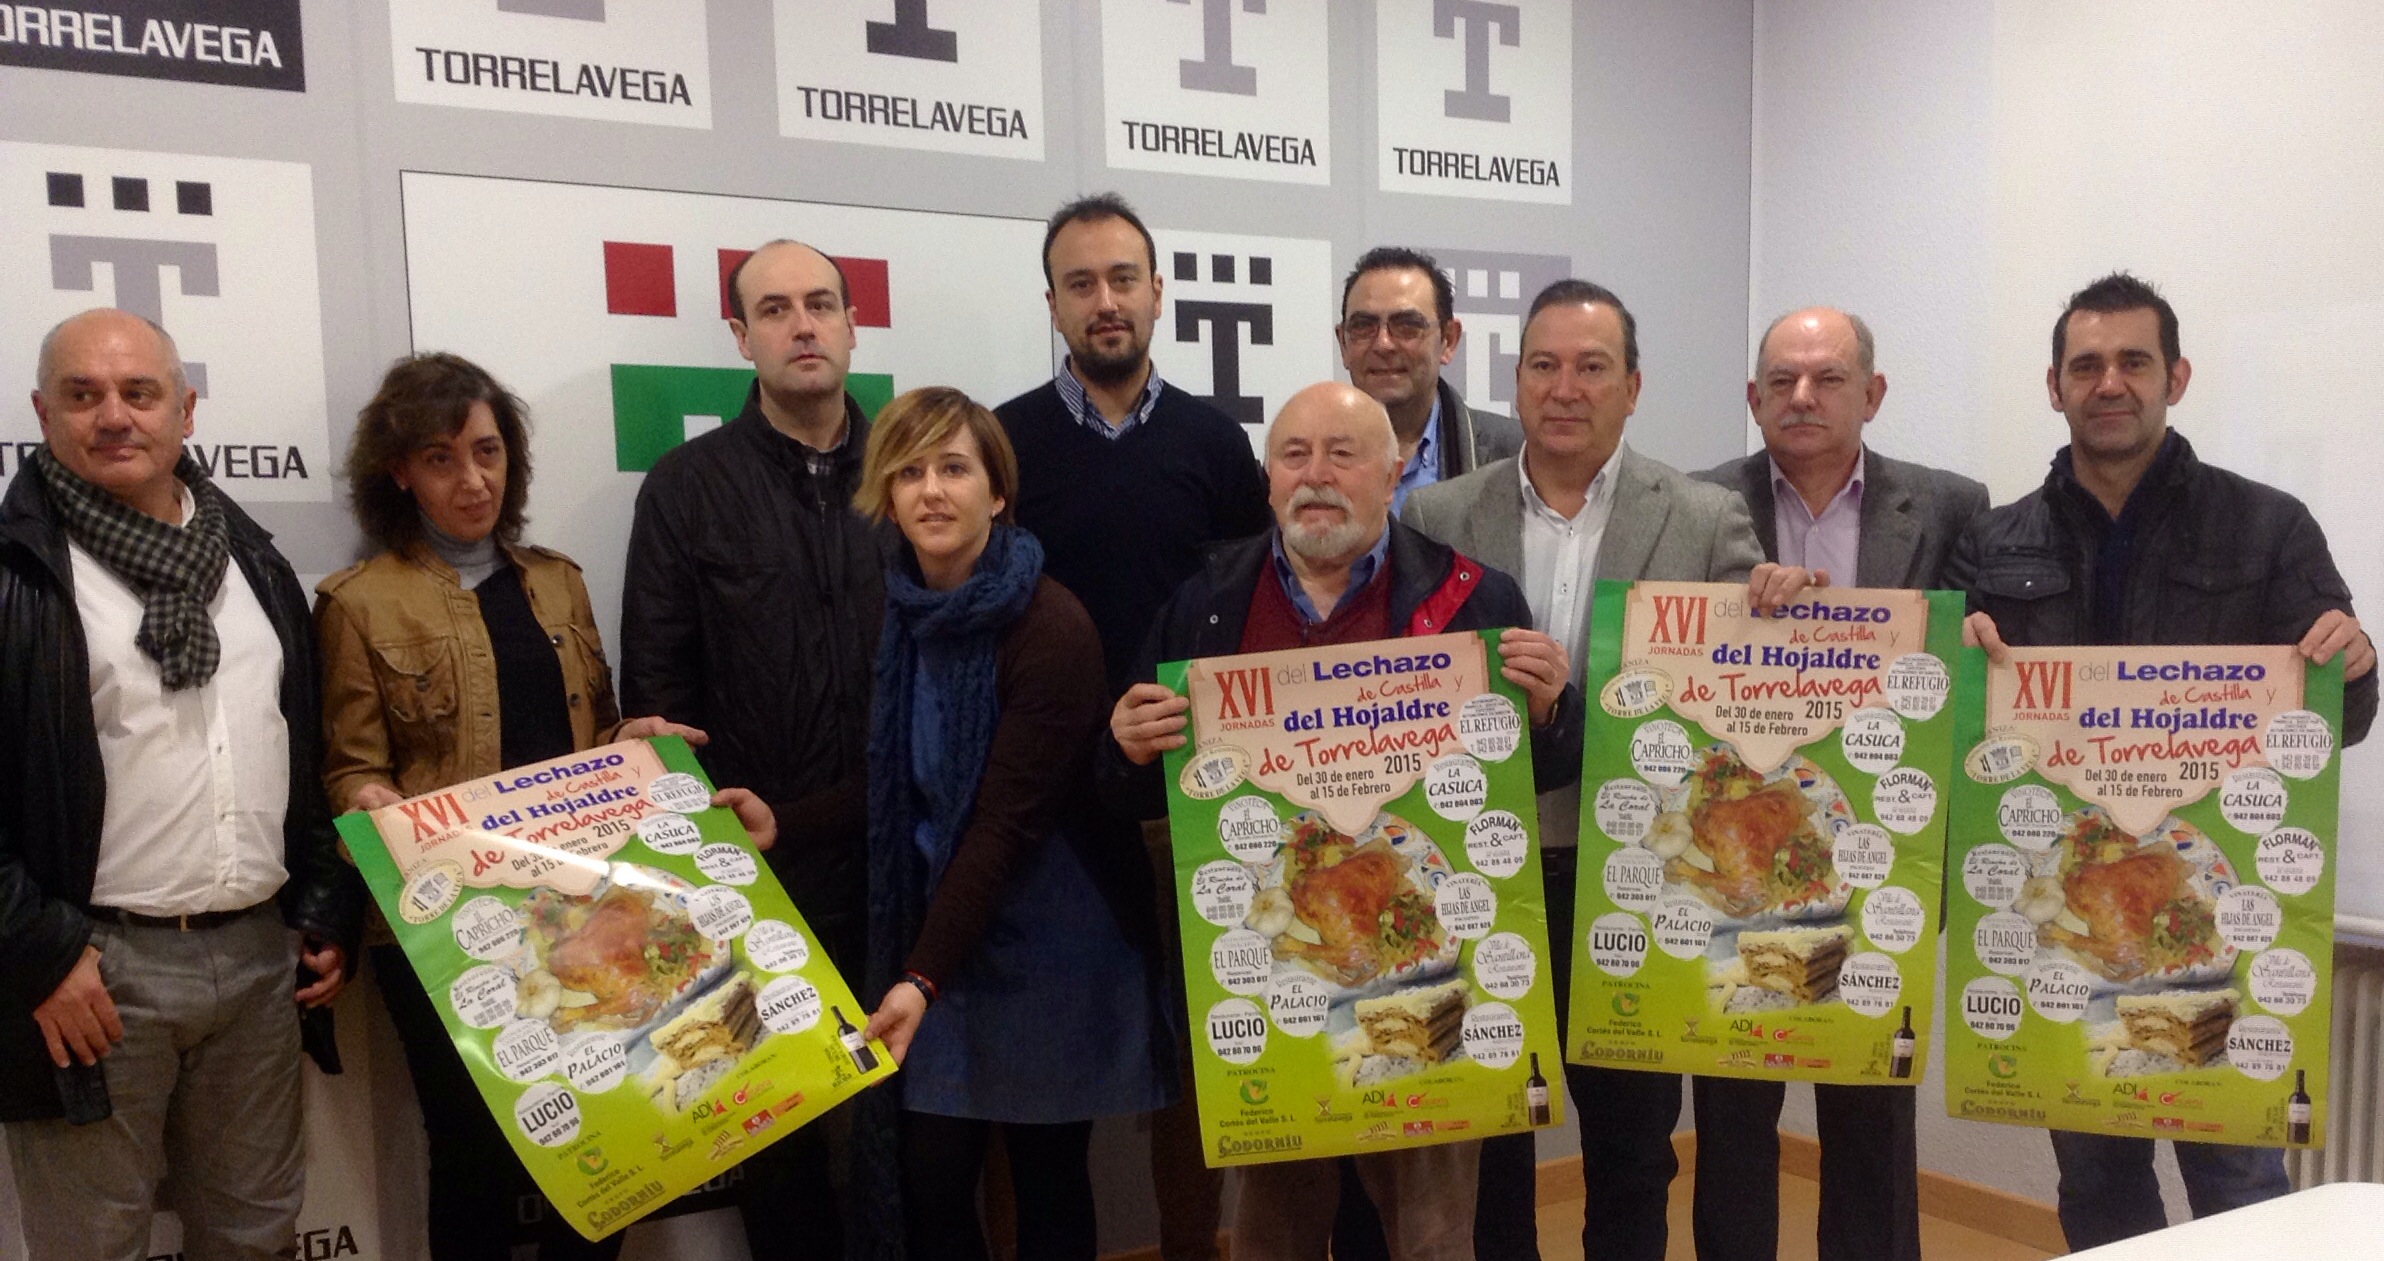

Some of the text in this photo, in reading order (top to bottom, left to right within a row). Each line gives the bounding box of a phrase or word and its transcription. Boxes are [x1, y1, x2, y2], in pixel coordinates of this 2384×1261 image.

[0, 4, 282, 67] ORRELAVEGA
[416, 47, 692, 106] TORRELAVEGA
[797, 86, 1028, 140] TORRELAVEGA
[1122, 120, 1316, 166] TORRELAVEGA
[1393, 147, 1560, 187] TORRELAVEGA
[1712, 597, 1743, 618] del
[1647, 594, 1708, 644] XVI
[1789, 624, 1898, 647] de Castilla y
[1648, 646, 1703, 656] JORNADAS
[1711, 642, 1752, 665] del
[1760, 645, 1880, 672] Hojaldre
[1277, 649, 1451, 685] del Lechazo
[2078, 660, 2266, 681] del Lechazo
[1215, 666, 1274, 719] XVI
[1357, 673, 1463, 702] de Castilla y
[1679, 675, 1716, 702] de
[1718, 668, 1881, 707] Torrelavega
[1887, 675, 1949, 691] EL REFUGIO
[2011, 660, 2072, 709] XVI
[2159, 683, 2276, 705] de Castilla y
[1283, 707, 1324, 732] del
[1331, 698, 1449, 729] Hojaldre
[1715, 700, 1843, 720] Del 30 de enero 2015
[2012, 712, 2069, 720] JORNADAS
[2078, 706, 2121, 728] del
[2130, 706, 2258, 734] Hojaldre
[1220, 718, 1275, 731] JORNADAS
[1460, 715, 1520, 733] EL REFUGIO
[1726, 720, 1808, 736] al 15 de Febrero
[1259, 747, 1294, 776] de
[1294, 723, 1456, 768] Torrelavega
[1631, 739, 1690, 761] CAPRICHO
[1845, 733, 1900, 747] CASUCA
[2046, 740, 2084, 766] de
[2086, 730, 2260, 767] Torrelavega
[2266, 734, 2332, 748] EL REFUGIO
[461, 783, 492, 803] del
[494, 751, 625, 794] Lechazo
[1297, 753, 1421, 786] Del 30 de enero 2015
[2085, 761, 2219, 782] Del 30 de enero 2015
[547, 766, 641, 801] de Castilla y
[1310, 780, 1390, 800] al 15 de Febrero
[1428, 779, 1482, 796] CASUCA
[1880, 773, 1931, 790] FLORMAN
[2097, 784, 2183, 798] al 15 de Febrero
[481, 810, 520, 831] del
[526, 784, 639, 818] Hojaldre
[2223, 794, 2282, 807] CASUCA
[399, 792, 469, 844] XVI
[1469, 816, 1519, 835] FLORMAN
[1999, 805, 2059, 826] CAPRICHO
[420, 826, 473, 853] JORNAD
[1220, 818, 1278, 841] CAPRICHO
[511, 858, 530, 872] Del
[560, 837, 588, 851] enero
[593, 819, 631, 838] 2015
[2262, 833, 2317, 850] FLORMAN
[470, 848, 504, 877] de
[531, 841, 608, 877] al 15 ebrero
[1605, 865, 1660, 888] EL PARQUE
[1458, 886, 1470, 899] LAS
[1654, 914, 1710, 931] PALACIO
[1678, 907, 1688, 916] EL
[1593, 931, 1646, 952] LUCIO
[1977, 929, 2033, 952] EL PARQUE
[1213, 947, 1268, 969] EL PARQUE
[1291, 984, 1302, 993] EL
[1840, 971, 1899, 988] SÁNCHEZ
[2029, 978, 2088, 995] PALACIO
[1270, 994, 1326, 1009] PALACIO
[1967, 996, 2021, 1015] LUCIO
[1211, 1016, 1265, 1042] LUCIO
[1464, 1024, 1522, 1042] SÁNCHEZ
[2228, 1034, 2291, 1052] SÁNCHEZ
[521, 1088, 575, 1135] LUCIO
